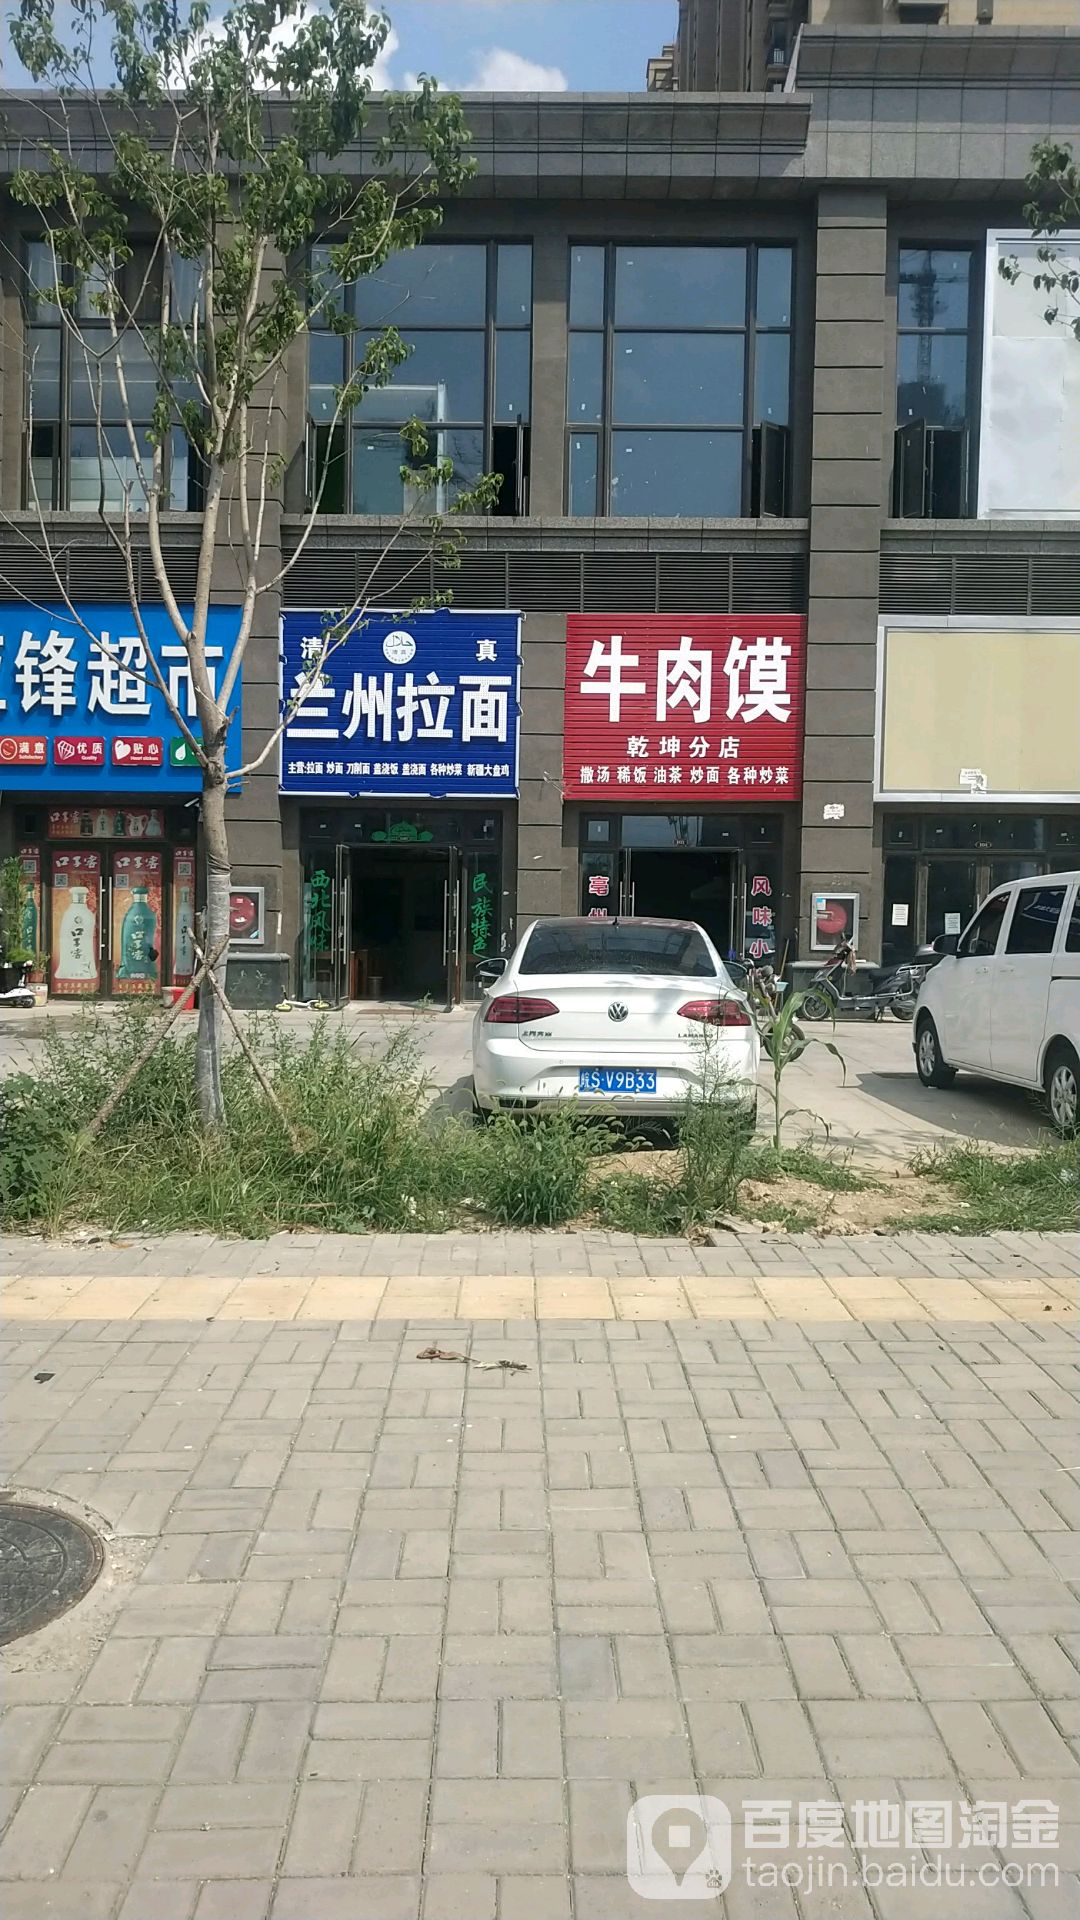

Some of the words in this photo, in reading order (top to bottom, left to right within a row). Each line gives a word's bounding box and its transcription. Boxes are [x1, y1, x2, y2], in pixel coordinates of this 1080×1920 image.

[475, 639, 498, 662] 真
[579, 635, 792, 724] 牛肉馍
[286, 671, 512, 742] 兰州拉面
[19, 742, 44, 754] 满意
[77, 742, 103, 754] 优质
[133, 743, 159, 755] 贴心
[626, 736, 741, 758] 乾坤分店
[326, 762, 343, 774] 炒面
[346, 762, 370, 775] 刀削面
[430, 763, 462, 776] 各种炒菜
[467, 764, 510, 777] 新疆大盘鸡
[616, 766, 647, 784] 稀饭
[653, 766, 682, 784] 油茶
[690, 766, 720, 784] 炒面
[727, 766, 790, 785] 各种炒菜
[310, 869, 332, 953] 西北风味
[470, 873, 494, 959] 民族特色
[749, 876, 772, 958] 风味小
